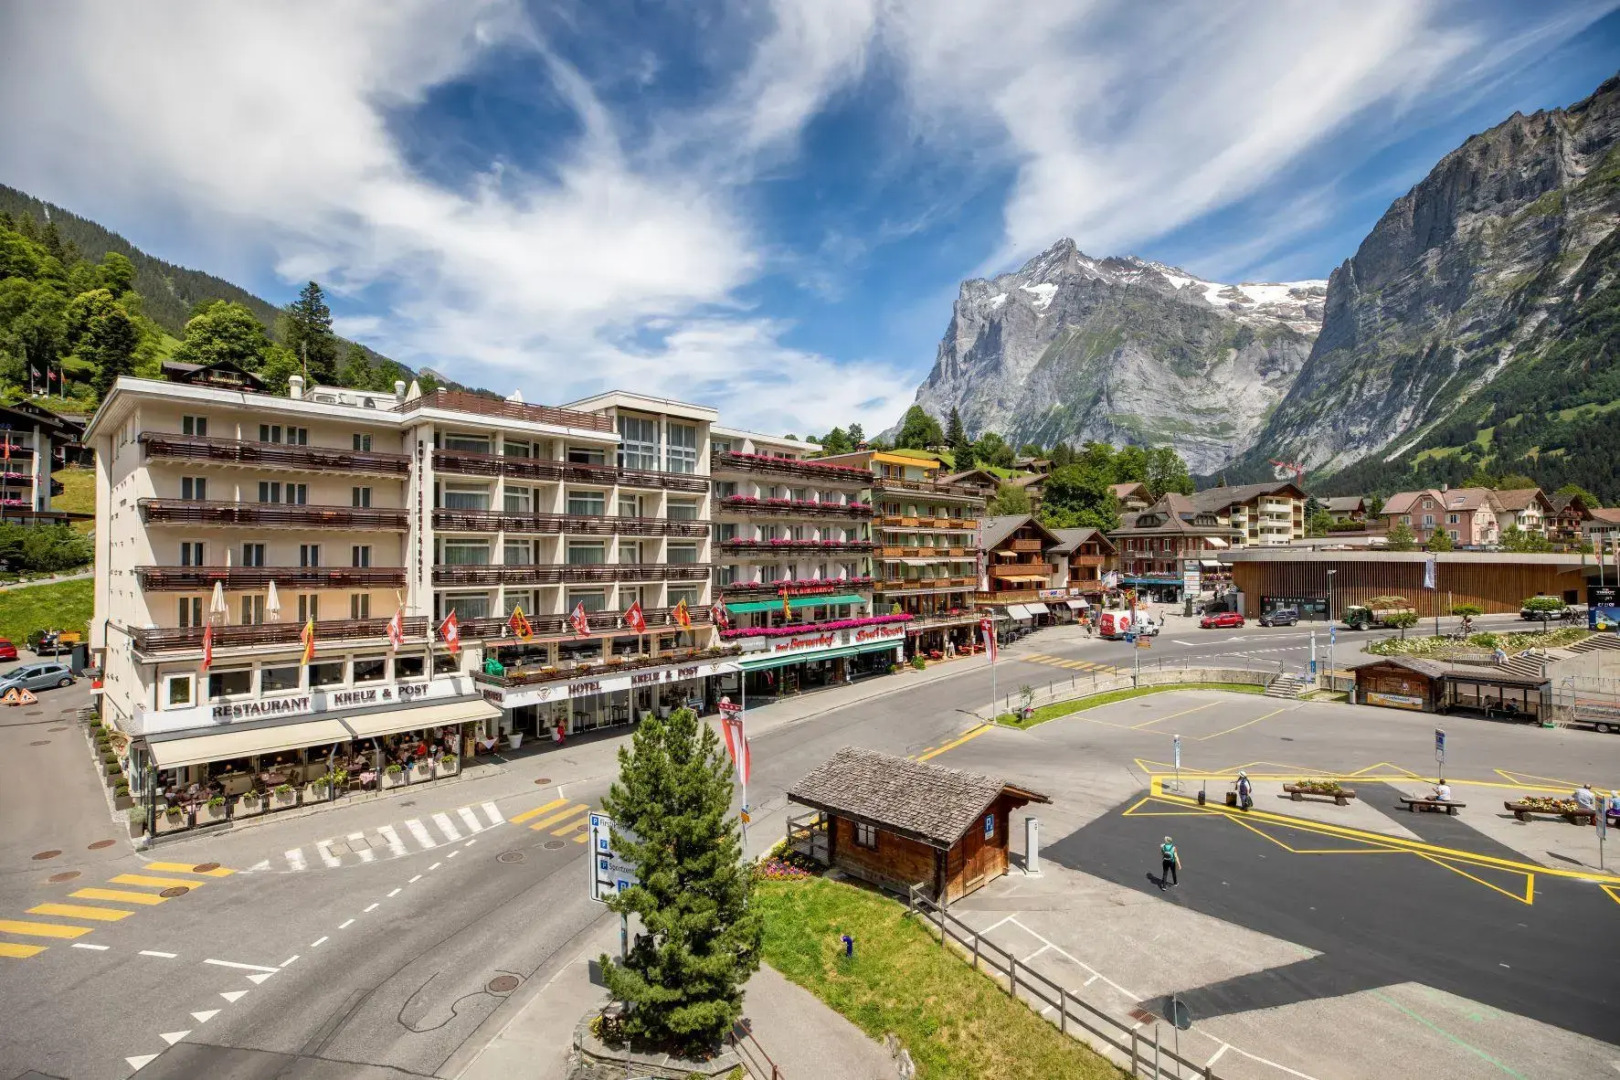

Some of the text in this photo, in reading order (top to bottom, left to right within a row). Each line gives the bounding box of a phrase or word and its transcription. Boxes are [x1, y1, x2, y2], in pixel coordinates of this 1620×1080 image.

[790, 632, 835, 648] Bernerhof
[568, 665, 699, 694] HOTEL KREUZ & POST
[212, 683, 429, 718] RESTAURANT KREUZ & POST
